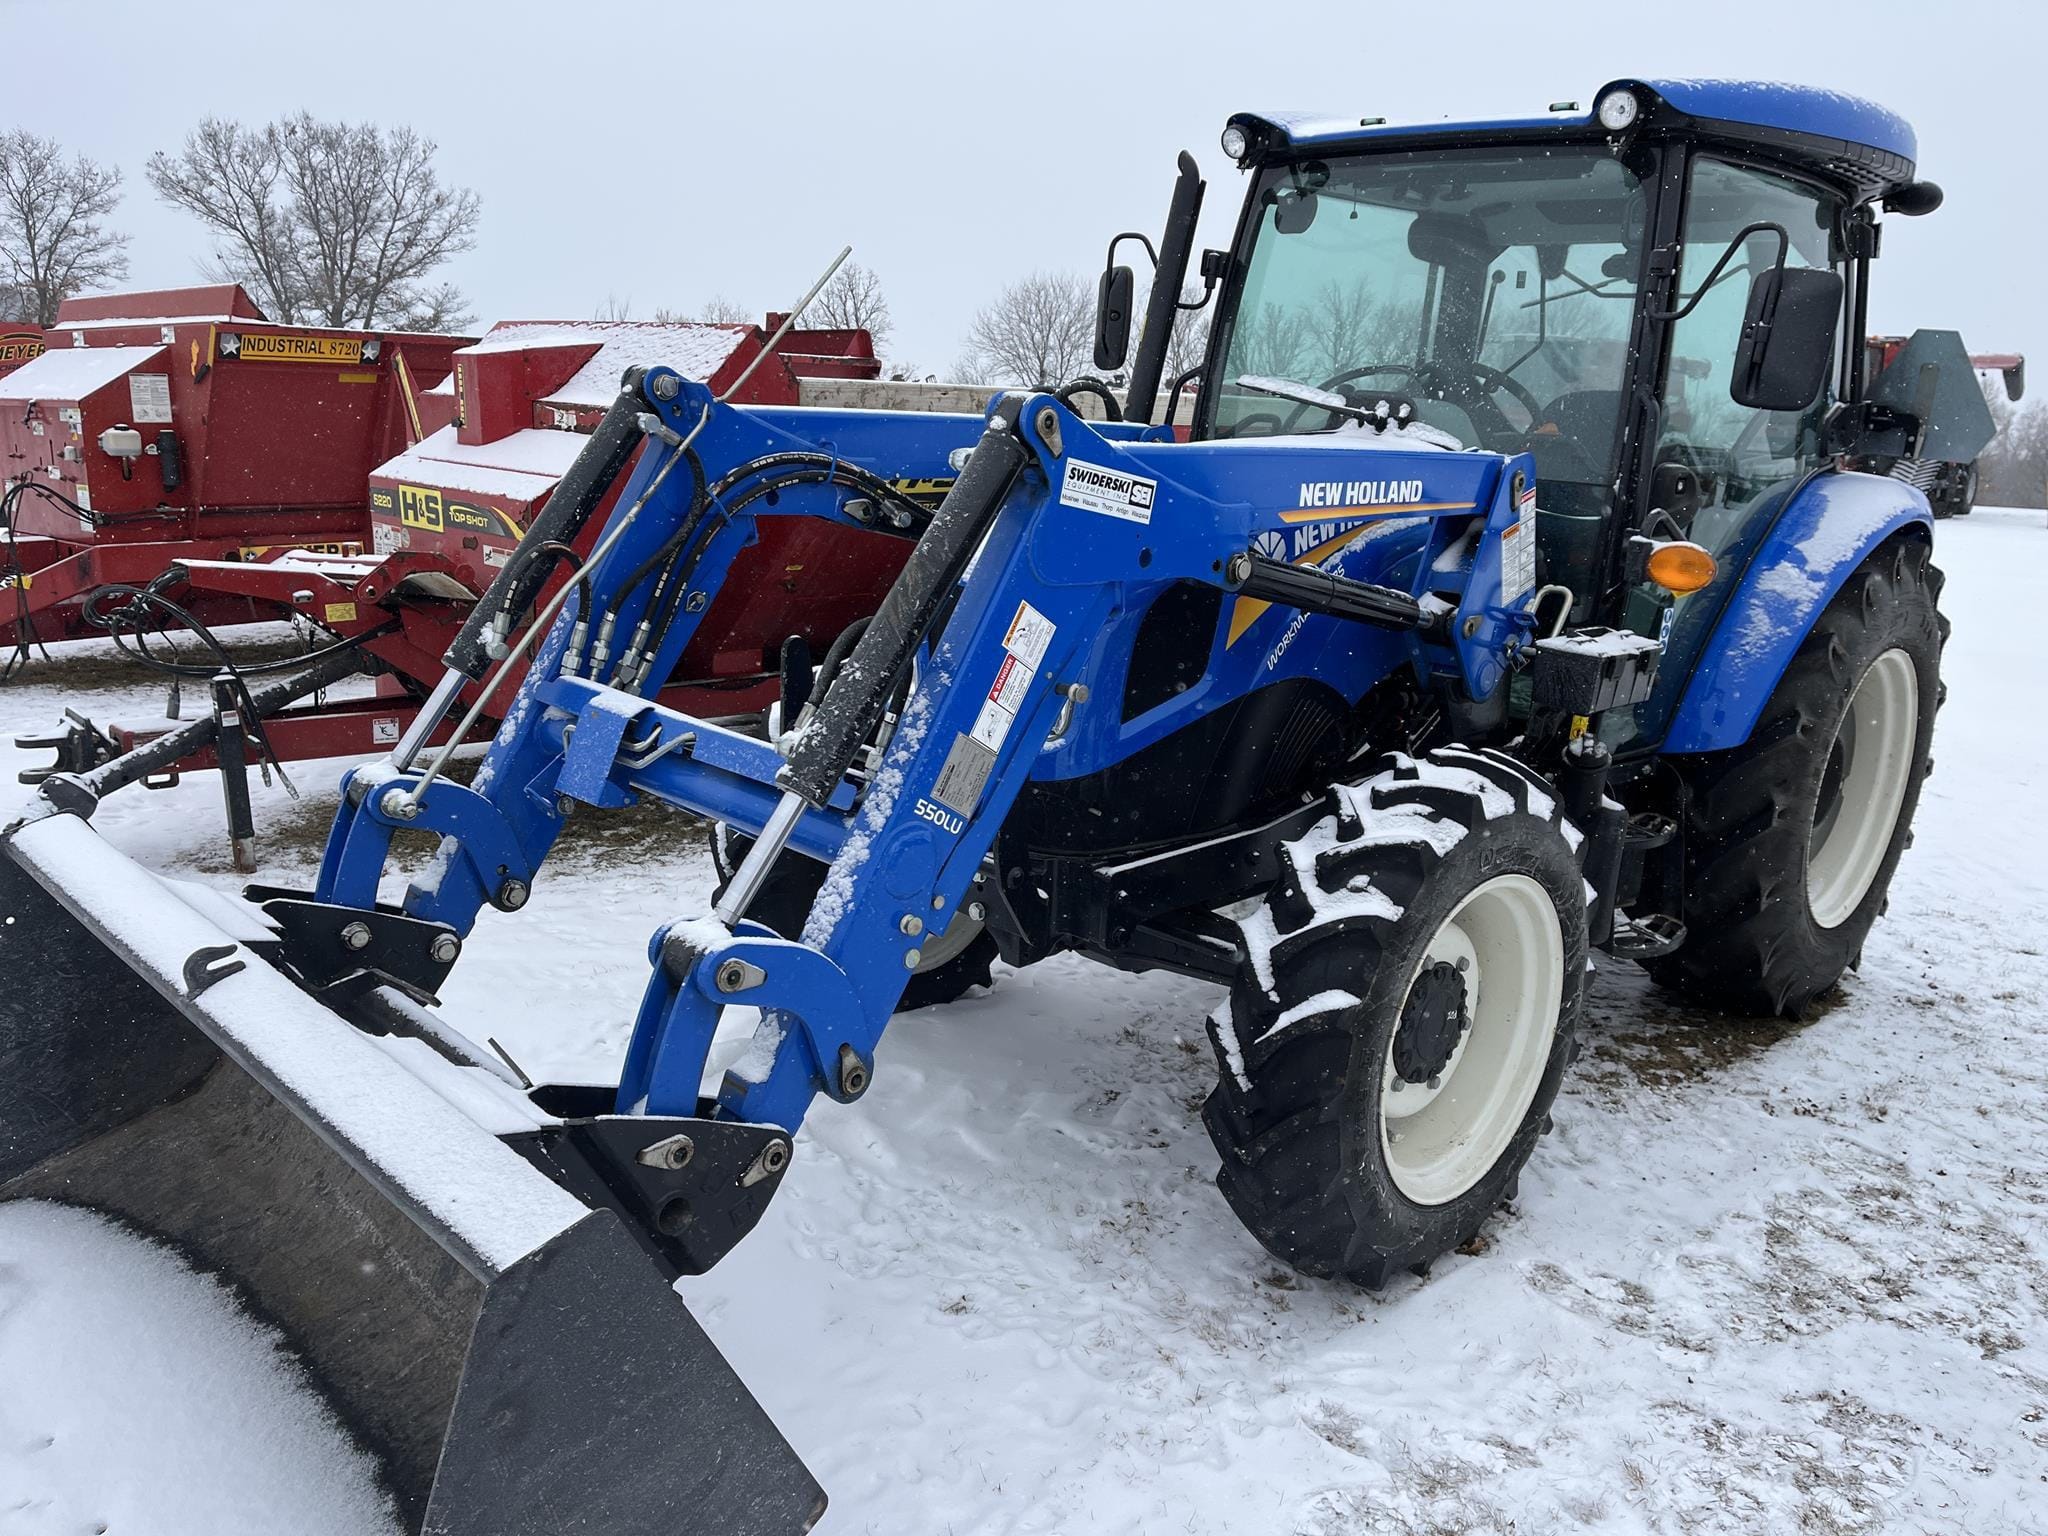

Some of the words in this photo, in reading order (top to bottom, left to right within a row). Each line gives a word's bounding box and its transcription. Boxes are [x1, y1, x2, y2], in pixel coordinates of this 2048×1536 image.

[242, 337, 325, 355] INDUSTRIAL
[329, 341, 360, 356] 8720
[1066, 481, 1110, 498] EQUIPMENT
[1068, 467, 1131, 494] SWIDERSKI
[1299, 482, 1343, 507] NEW
[1345, 480, 1423, 505] HOLLAND
[401, 490, 441, 527] H&S
[1295, 523, 1335, 557] NEW
[1267, 612, 1311, 671] WORKM
[995, 657, 1014, 690] DANGER
[914, 798, 963, 835] 550LU
